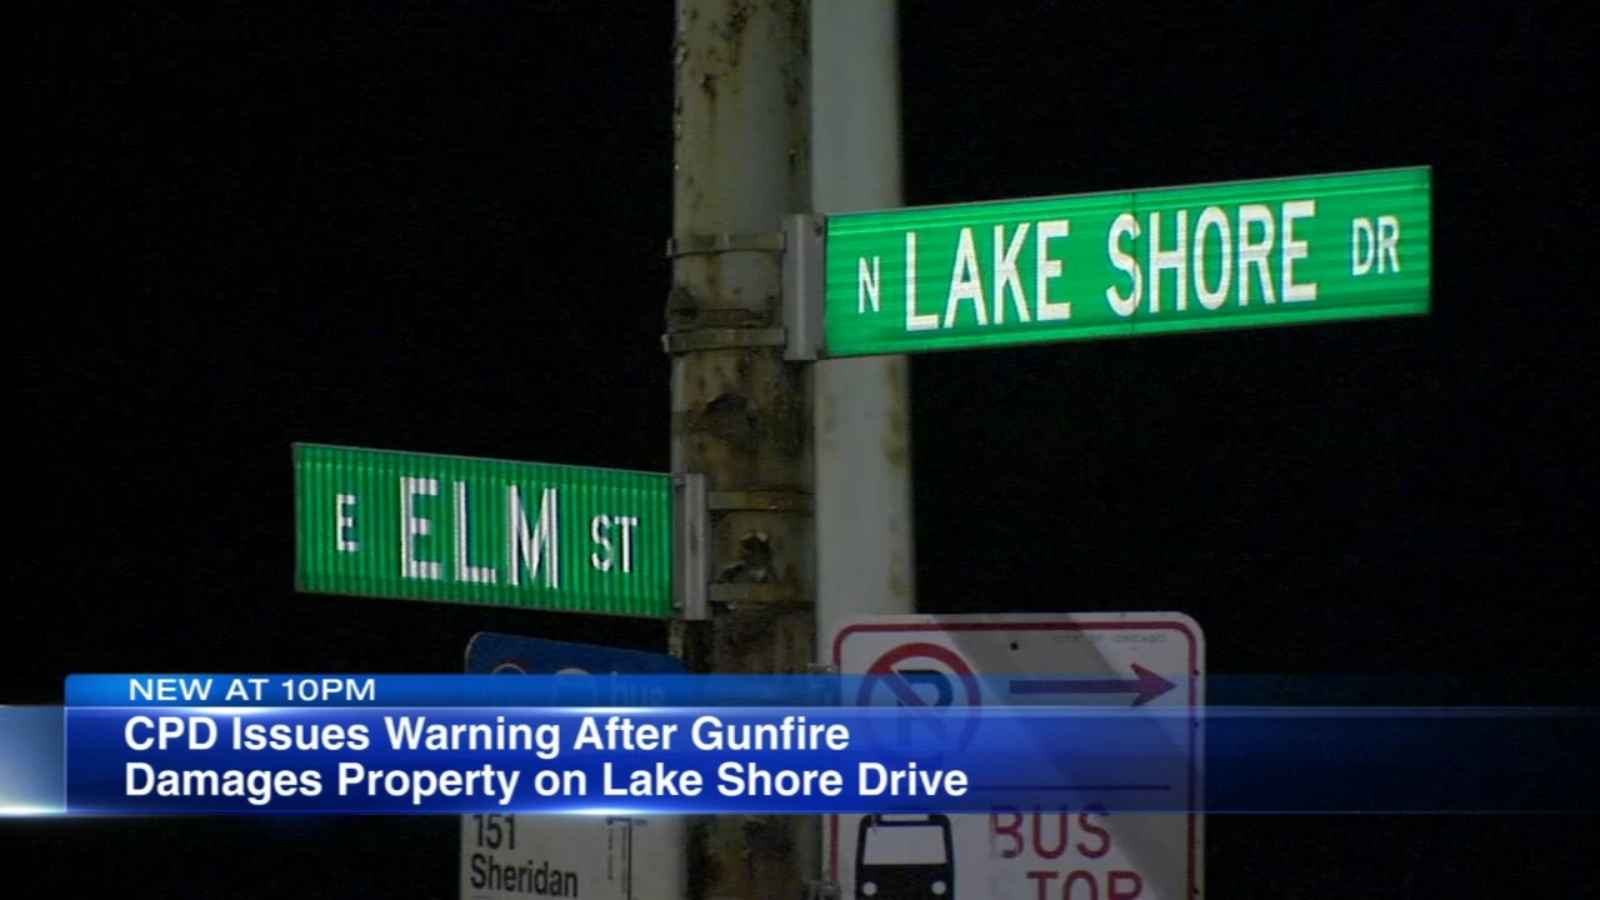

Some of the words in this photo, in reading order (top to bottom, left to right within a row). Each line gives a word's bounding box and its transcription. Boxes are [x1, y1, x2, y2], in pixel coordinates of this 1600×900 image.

[858, 256, 880, 313] N
[906, 219, 1071, 331] LAKE
[1106, 199, 1318, 316] SHORE
[1352, 215, 1401, 276] DR
[336, 493, 359, 552] E
[400, 476, 559, 589] ELM
[592, 514, 639, 573] ST
[473, 814, 516, 850] 151
[988, 804, 1111, 859] BUS
[470, 853, 578, 898] Sheridan
[989, 870, 1143, 900] TOP
